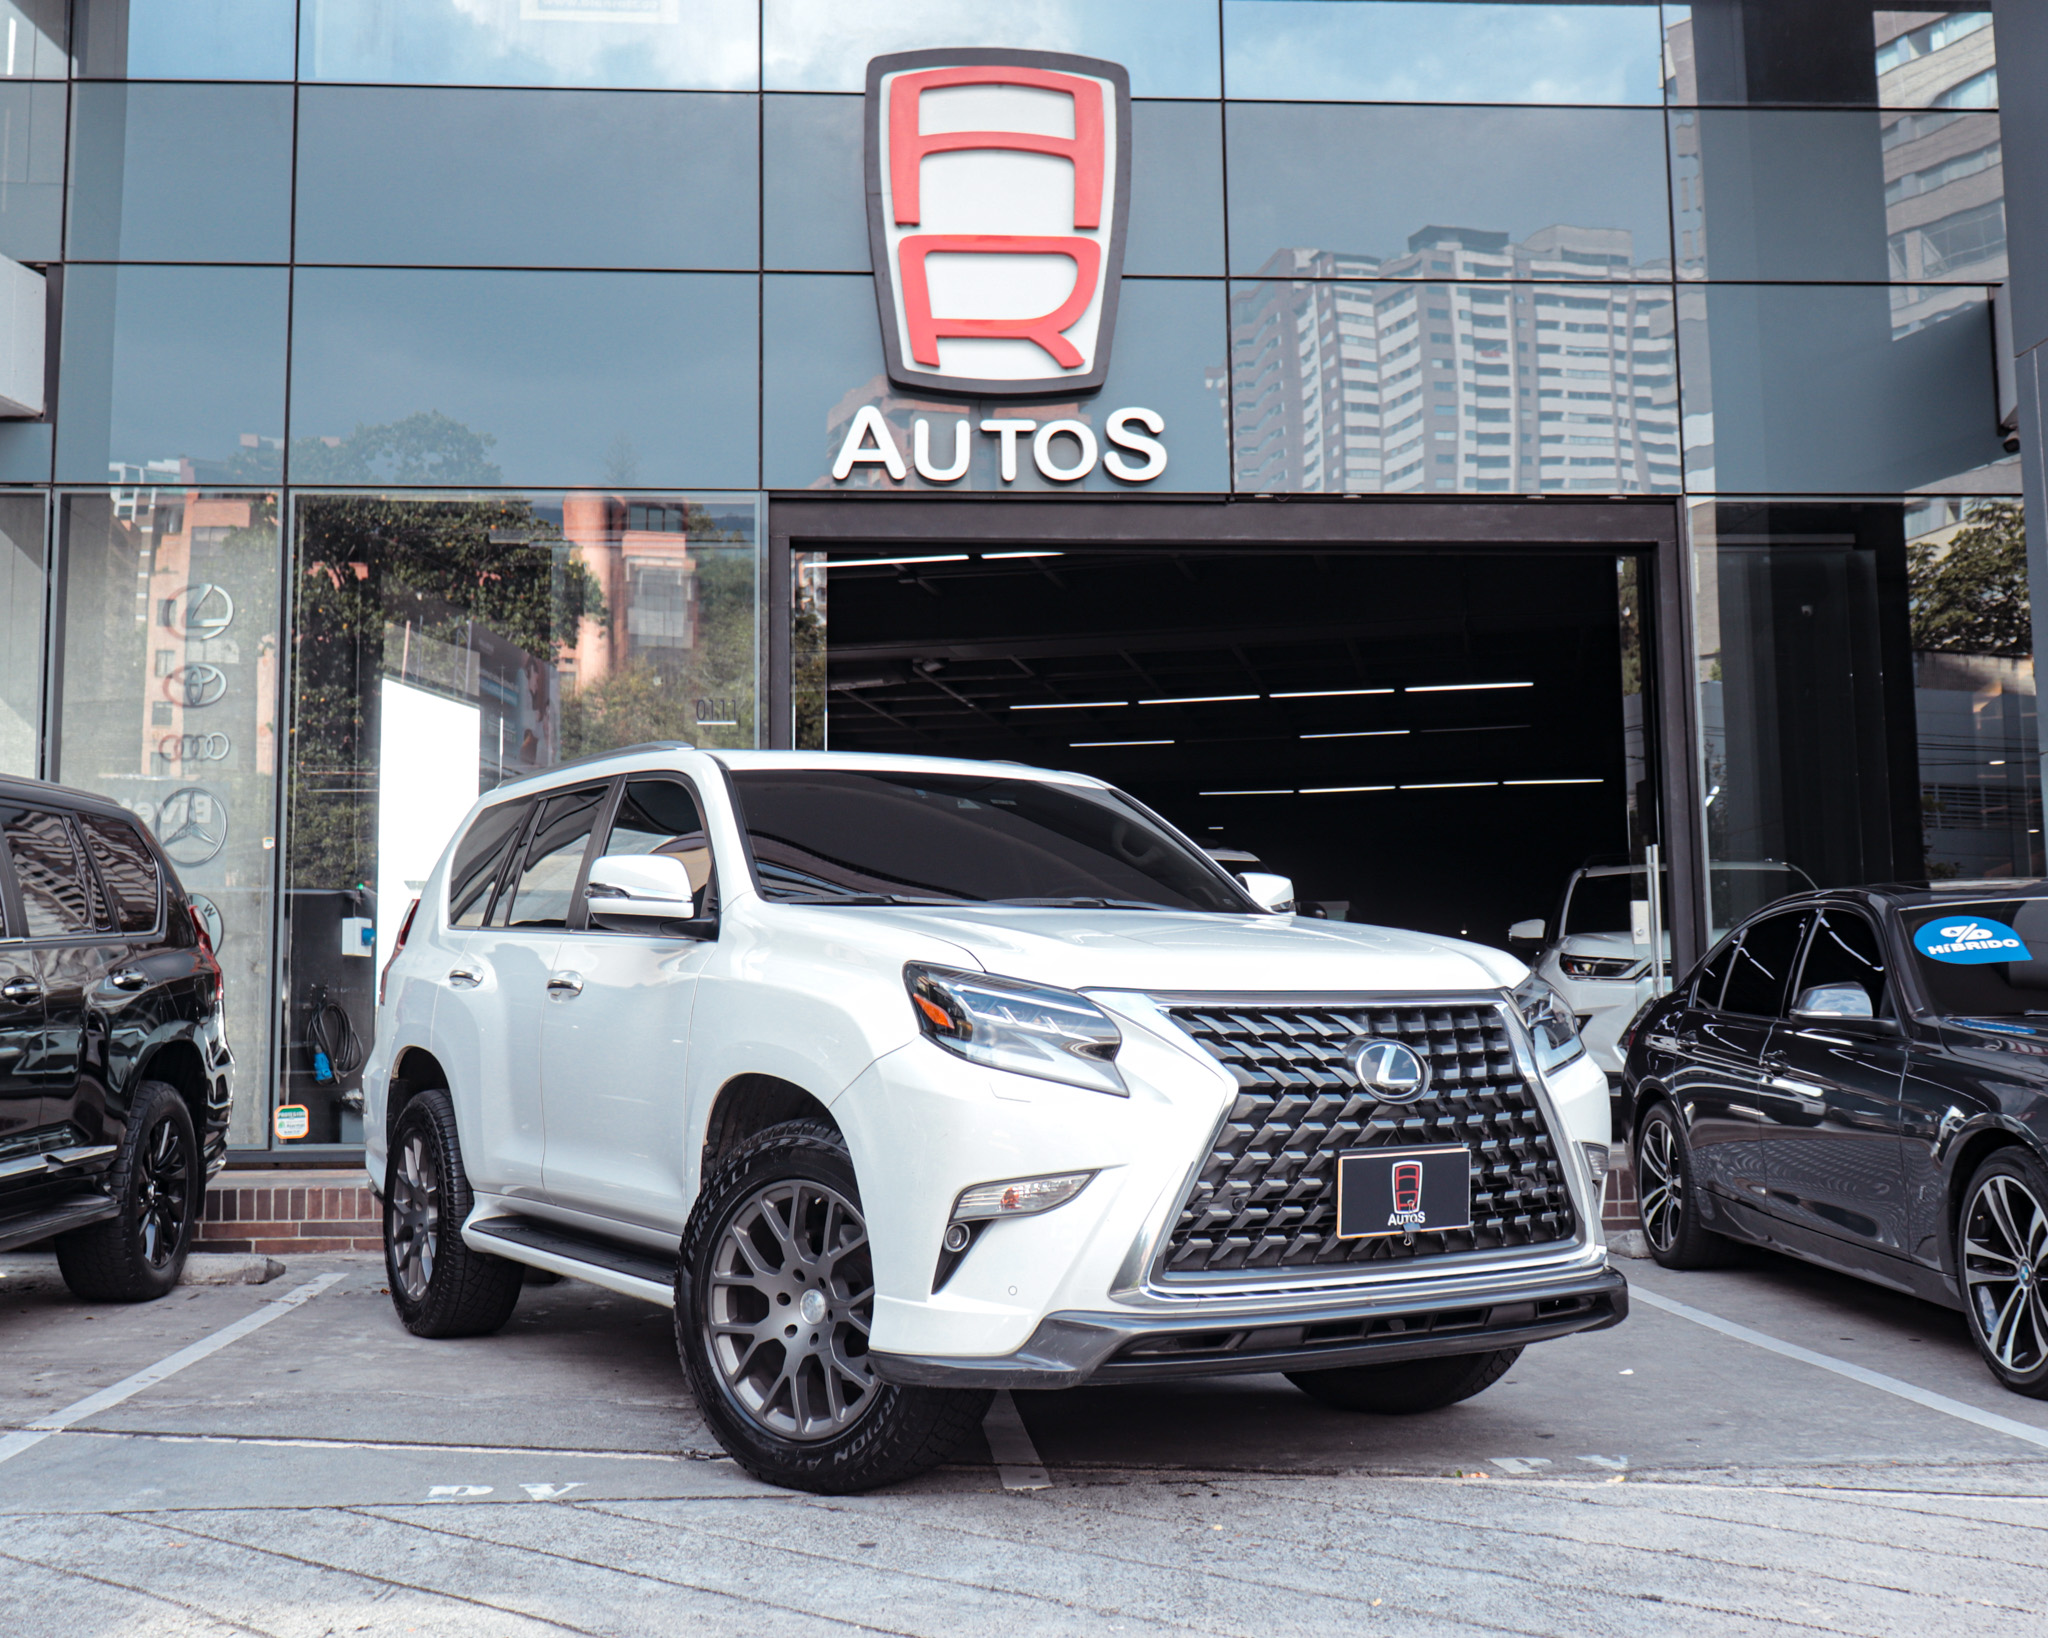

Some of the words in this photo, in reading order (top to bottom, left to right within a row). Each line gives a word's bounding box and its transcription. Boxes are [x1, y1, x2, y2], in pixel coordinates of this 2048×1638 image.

[832, 405, 1167, 482] AUTOS
[688, 1160, 751, 1262] PIRELLI
[1387, 1211, 1426, 1226] AUTOS
